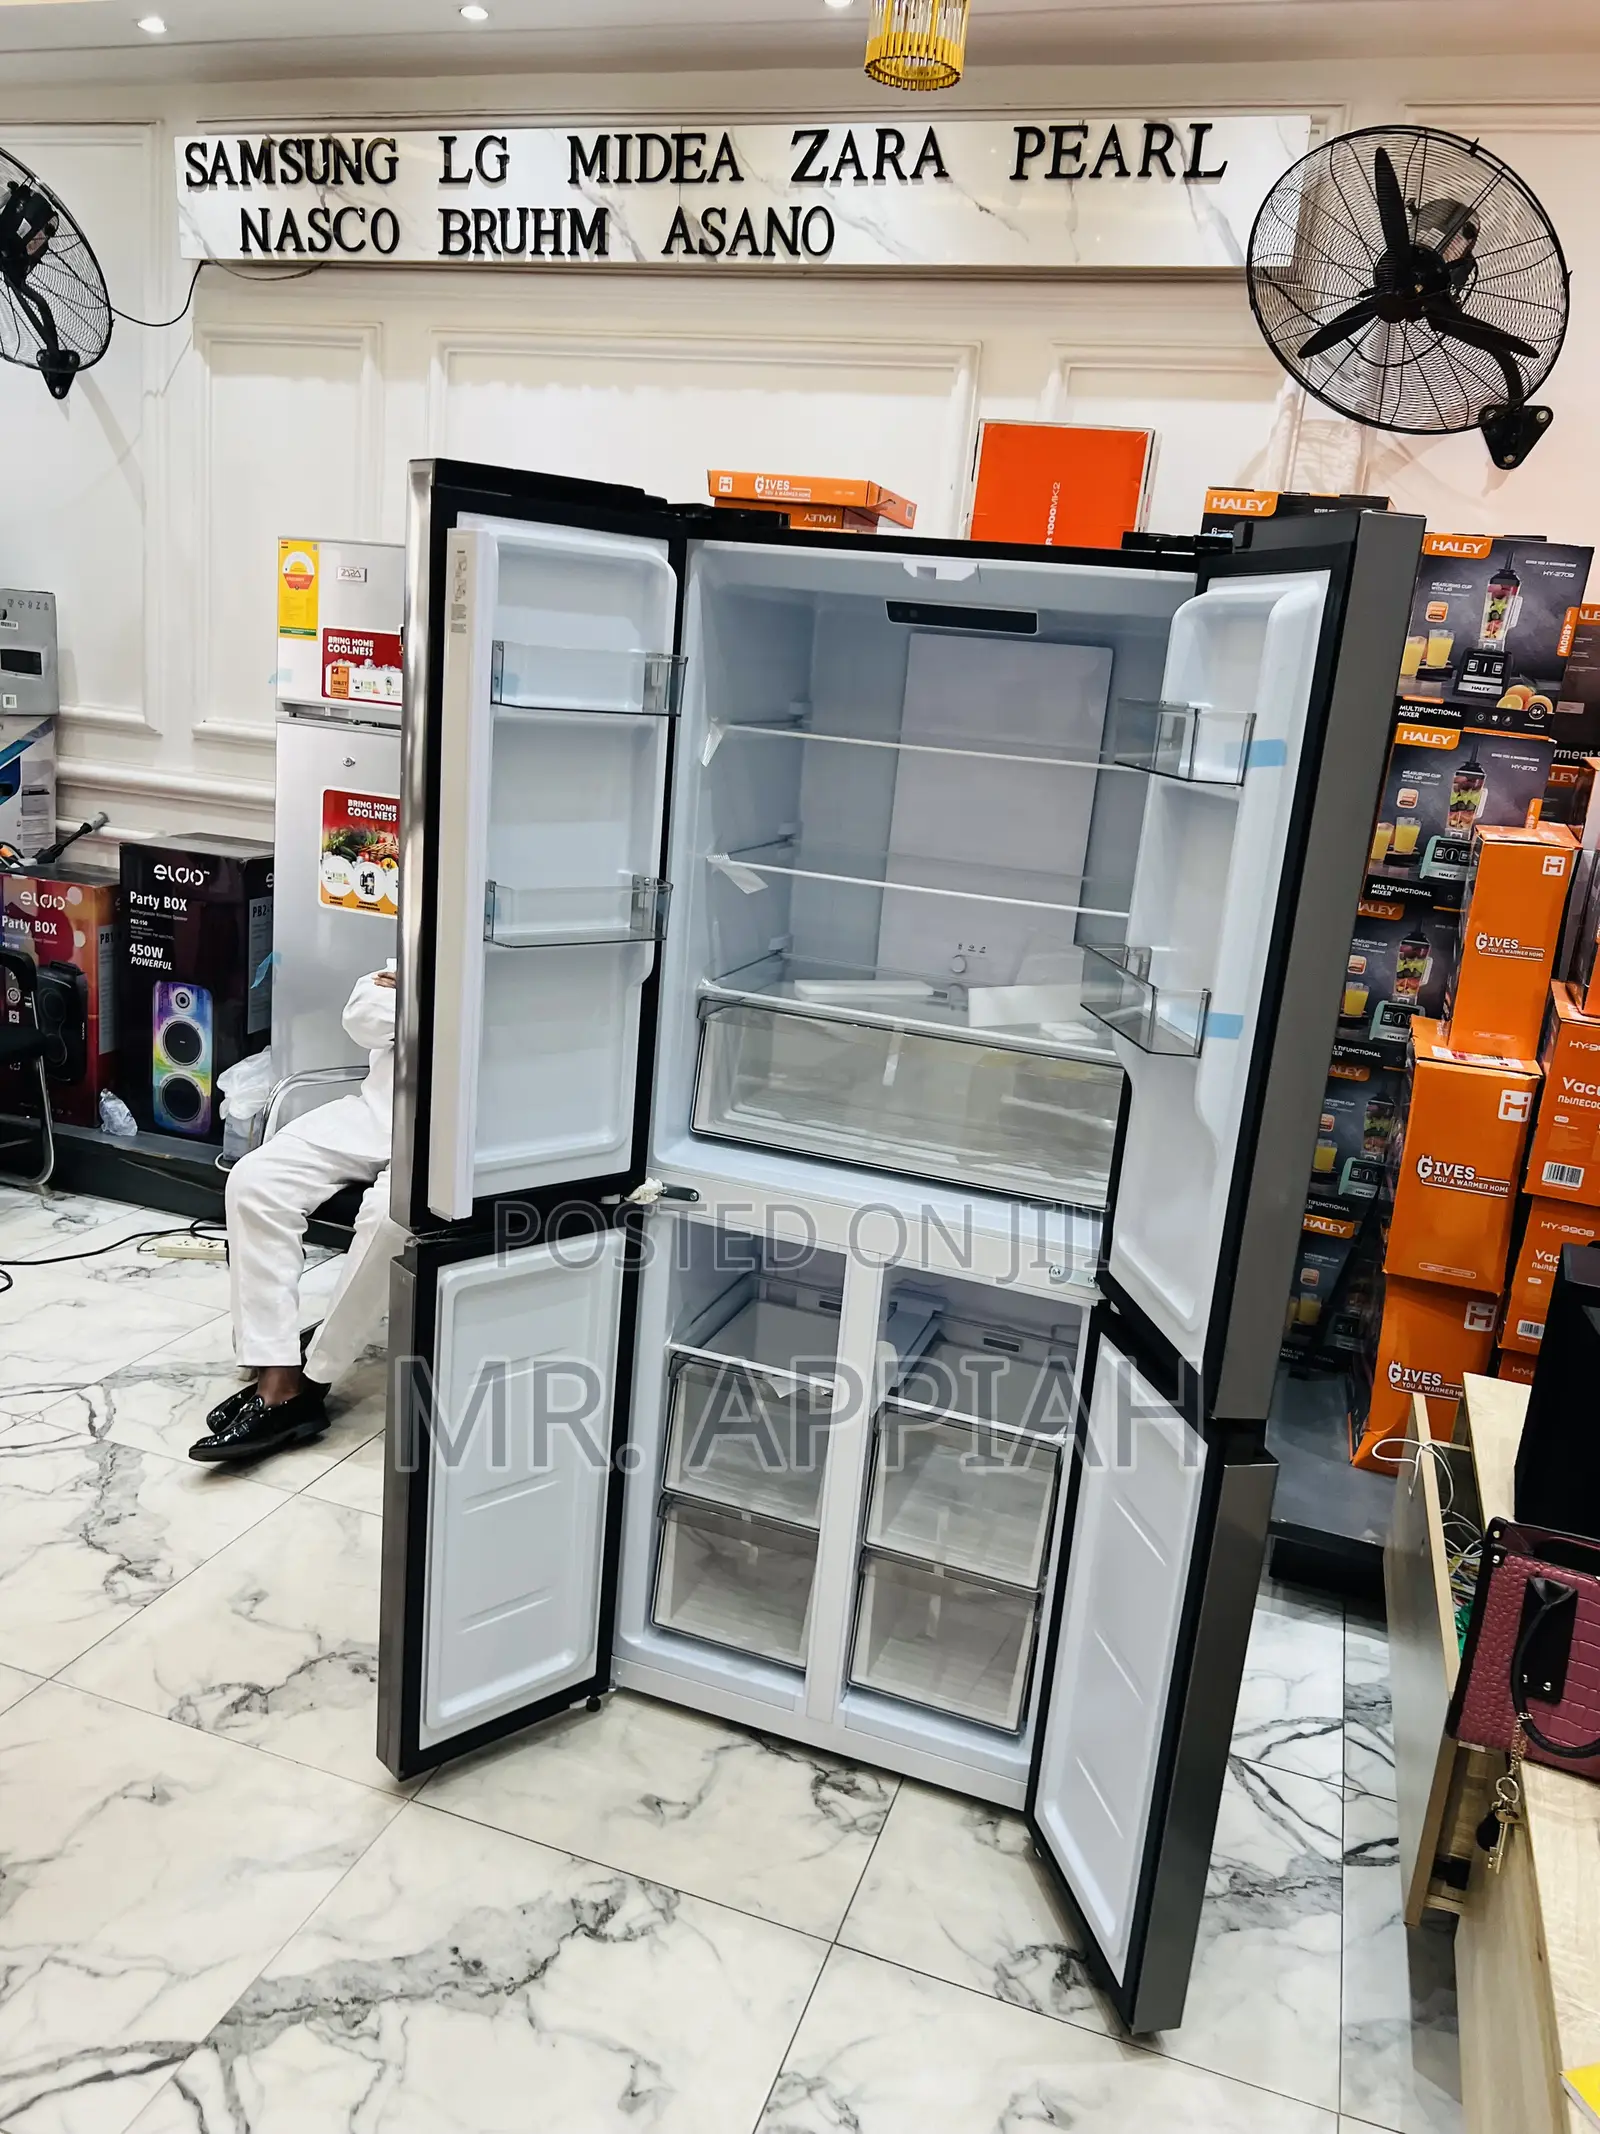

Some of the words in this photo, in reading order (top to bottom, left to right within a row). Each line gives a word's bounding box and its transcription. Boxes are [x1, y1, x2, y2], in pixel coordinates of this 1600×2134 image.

[185, 135, 398, 187] SAMSUNG
[438, 135, 509, 185] LG
[567, 133, 744, 184] MIDEA
[791, 125, 949, 182] ZARA
[1010, 122, 1227, 179] PEARL
[240, 208, 400, 254] NASCO
[438, 208, 609, 255] BRUHM
[661, 206, 834, 256] ASANO
[755, 476, 790, 493] GIVES
[1212, 497, 1267, 511] HALEY
[1431, 540, 1483, 554] HALEY
[328, 635, 350, 645] BRING
[352, 638, 374, 647] HOME
[327, 644, 374, 656] COOLNESS
[1398, 711, 1420, 719] MIXER
[1399, 705, 1462, 718] MULTIFUNCTIONAL
[1402, 730, 1451, 745] HALEY
[1549, 772, 1579, 783] LEY
[347, 799, 372, 809] BRING
[373, 803, 397, 813] HOME
[347, 807, 397, 822] COOLNESS
[1371, 889, 1392, 897] MIXER
[1372, 883, 1432, 897] MULTIFUNCTIONAL
[130, 891, 160, 910] Party
[164, 896, 187, 911] BOX
[1, 915, 31, 934] Party
[35, 921, 58, 936] BOX
[1475, 932, 1519, 950] GIVES
[129, 943, 164, 959] 450W
[131, 956, 172, 970] POWERFUL
[1333, 1045, 1381, 1058] LTIFUNCTIONAL
[1329, 1064, 1363, 1077] ALEY
[1417, 1155, 1476, 1181] GIVES
[1433, 1175, 1448, 1183] YOU
[1456, 1180, 1488, 1190] WARMER
[1303, 1218, 1346, 1234] HALEY
[1541, 1220, 1595, 1237] HY-9908
[1388, 1361, 1442, 1386] GIVES
[1402, 1381, 1416, 1389] YOU
[1424, 1386, 1455, 1397] WARMER
